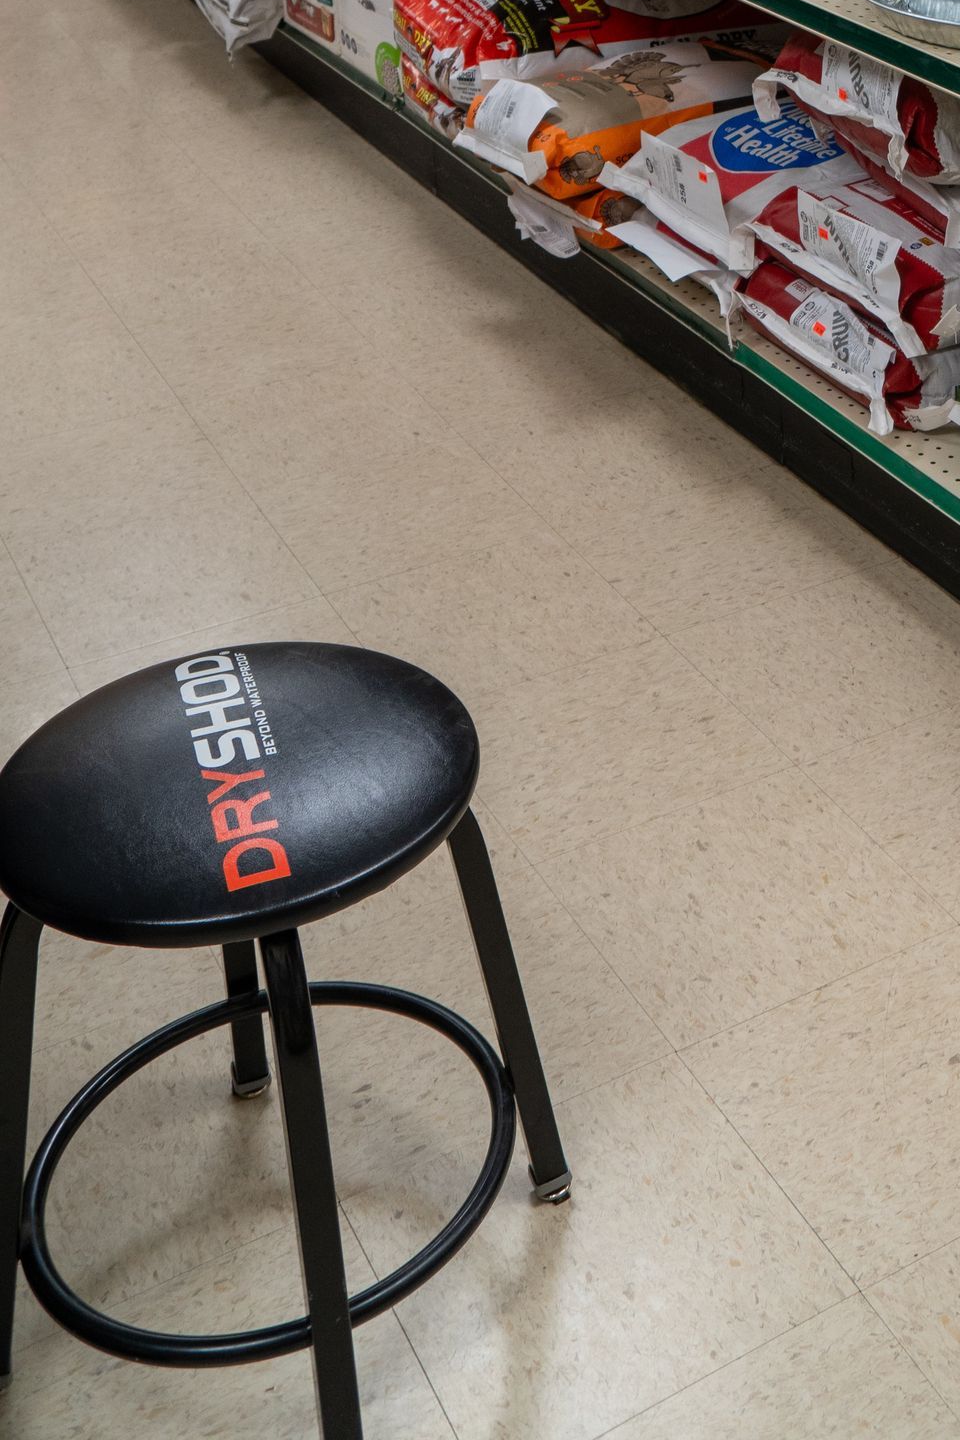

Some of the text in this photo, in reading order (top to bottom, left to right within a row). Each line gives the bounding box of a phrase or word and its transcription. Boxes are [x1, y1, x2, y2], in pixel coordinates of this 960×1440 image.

[723, 124, 801, 168] Health
[761, 116, 838, 161] Lifetime
[679, 182, 687, 205] 25#
[233, 651, 278, 756] BEYOND WATERPROOF
[174, 653, 292, 893] DRYSHOD
